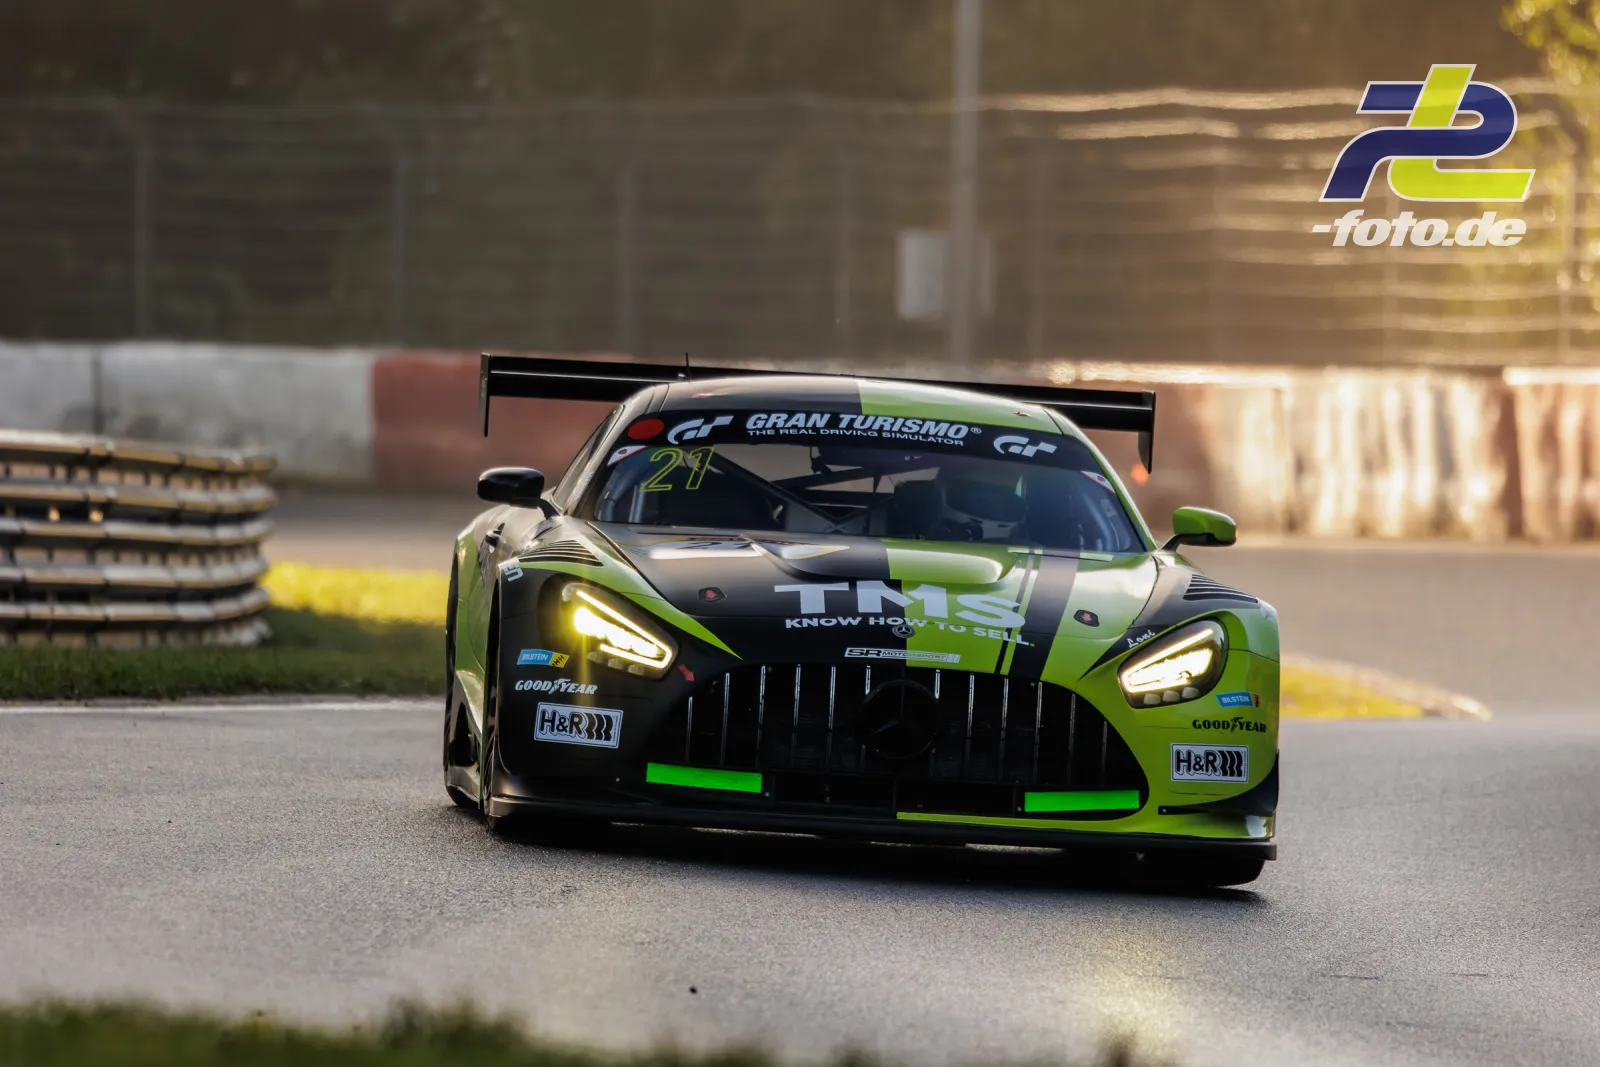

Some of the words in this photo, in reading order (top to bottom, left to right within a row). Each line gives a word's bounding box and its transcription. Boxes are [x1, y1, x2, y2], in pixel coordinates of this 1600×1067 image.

[746, 413, 831, 430] GRAN
[820, 429, 878, 437] DRIVING
[882, 432, 964, 446] SIMULATOR
[639, 446, 715, 492] 21
[774, 580, 1026, 628] TMS
[785, 617, 862, 629] KNOW
[868, 617, 928, 628] HOW
[937, 621, 967, 633] TO
[521, 653, 549, 661] BILSTEIN
[847, 648, 883, 657] SR
[1221, 695, 1250, 704] BILSTEIN
[540, 708, 585, 740] H&R
[1175, 749, 1220, 776] H&R
